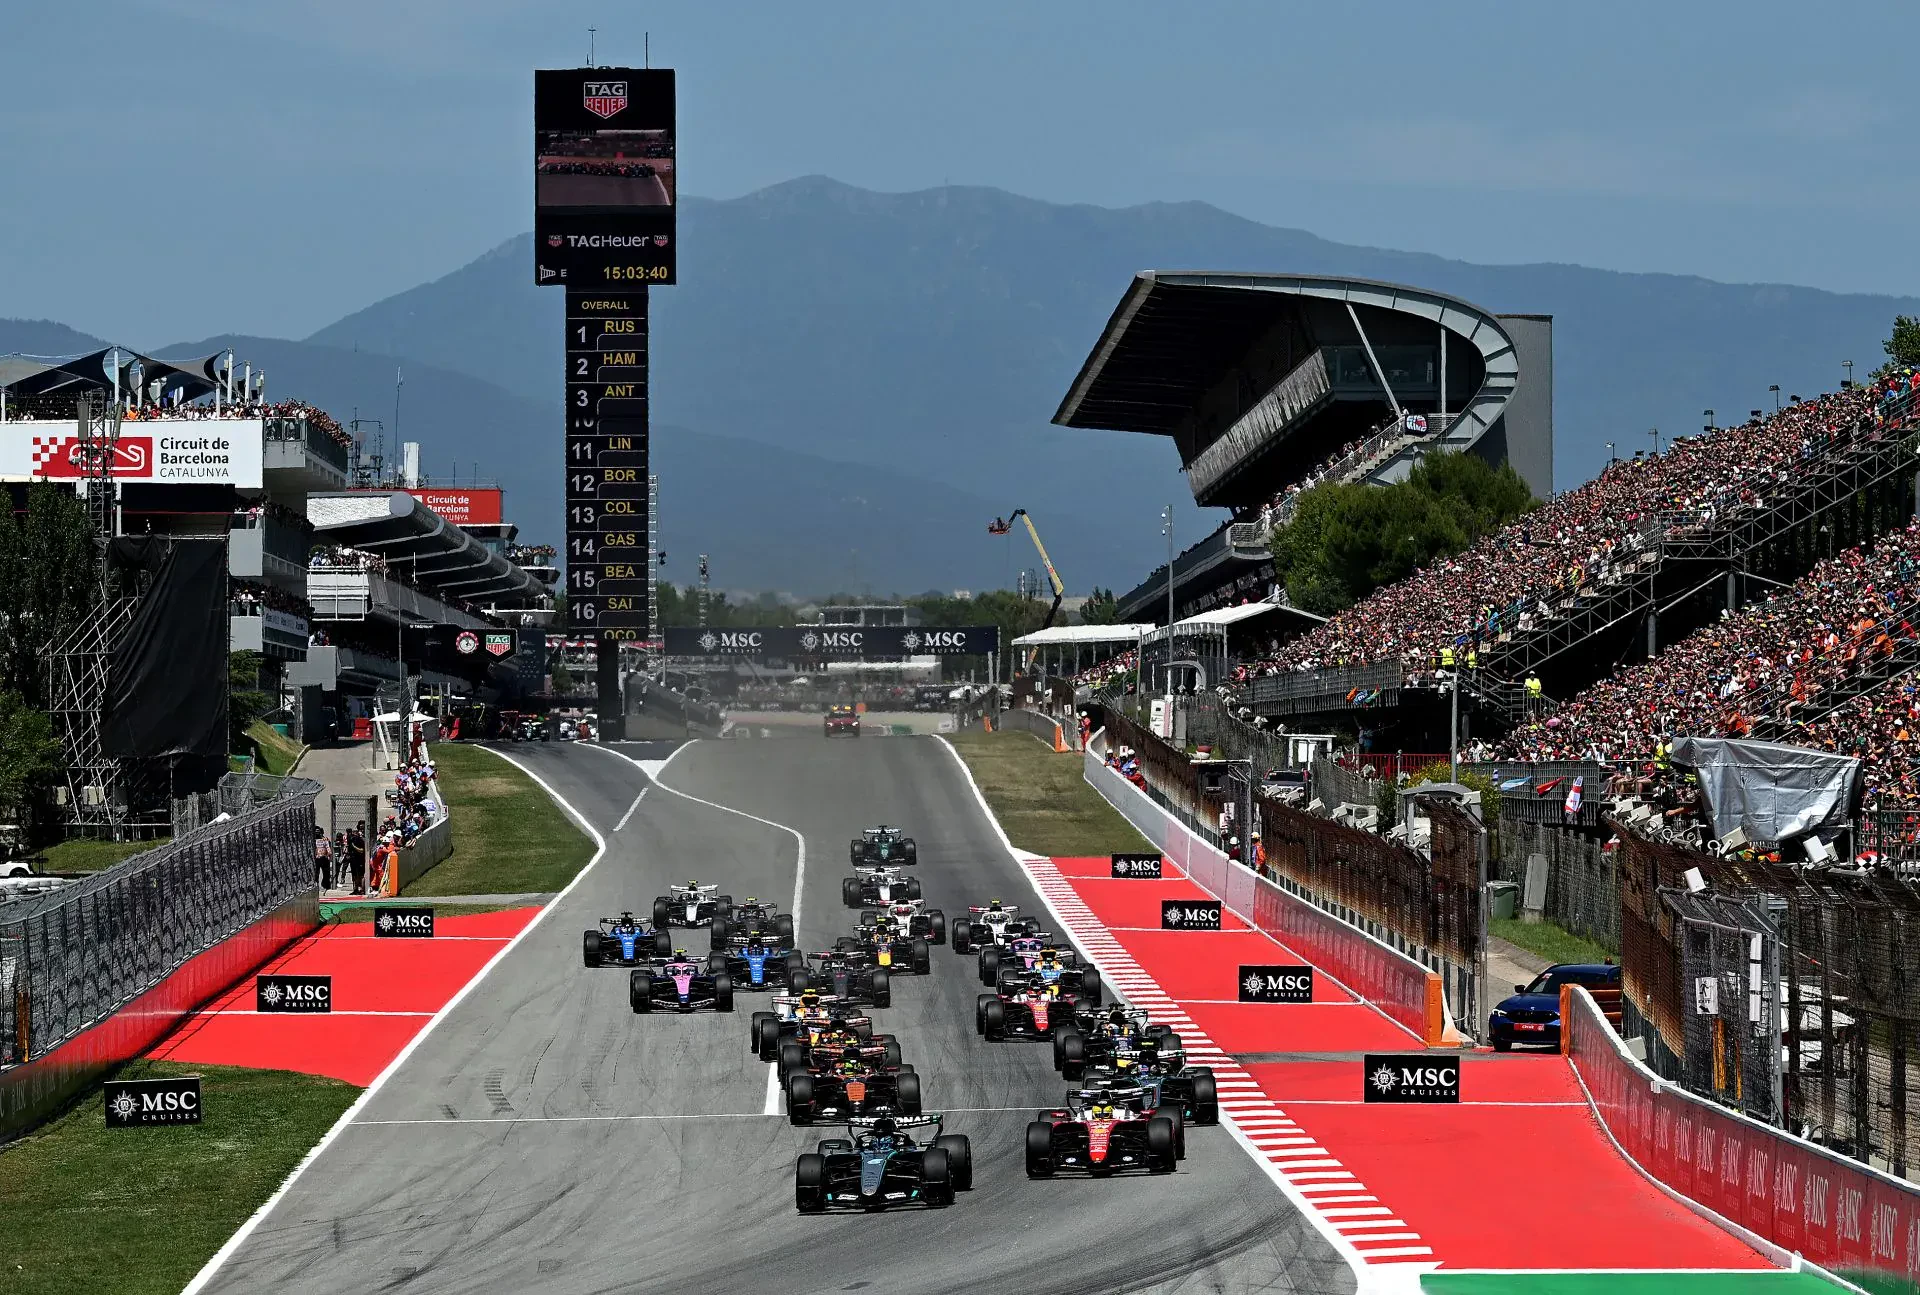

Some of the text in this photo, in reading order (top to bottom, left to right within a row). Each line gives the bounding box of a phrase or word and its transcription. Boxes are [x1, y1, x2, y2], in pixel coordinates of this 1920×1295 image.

[587, 84, 624, 96] TAG
[586, 98, 625, 116] HEUER
[560, 269, 567, 277] E
[603, 266, 668, 280] 15:03:40
[581, 301, 630, 310] OVERALL
[577, 320, 635, 343] 1 RUS
[576, 352, 636, 375] 2 HAM
[576, 385, 635, 407] 3 ANT
[160, 437, 229, 450] Circuit de
[572, 437, 631, 460] 11 LIN
[160, 452, 229, 464] Barcelona
[160, 467, 229, 477] CATALUNYA
[571, 469, 636, 492] 12 BOR
[427, 495, 470, 504] Circuit de
[571, 501, 636, 524] 13 COL
[571, 533, 636, 556] 14 GAS
[572, 565, 636, 588] 15 BEA
[572, 597, 633, 620] 16 SAI
[721, 632, 762, 647] MSC
[823, 632, 863, 647] MSC
[924, 631, 966, 648] MSC
[487, 644, 509, 655] HEUER
[1130, 860, 1160, 871] MSC
[396, 915, 431, 927] MSC
[1184, 908, 1219, 921] MSC
[1266, 975, 1310, 990] MSC
[285, 985, 328, 1000] MSC
[1401, 1068, 1456, 1087] MSC
[141, 1091, 197, 1111] MSC
[142, 1113, 198, 1121] CRUISES
[1844, 1187, 1862, 1243] MSC
[1878, 1203, 1898, 1260] MSC
